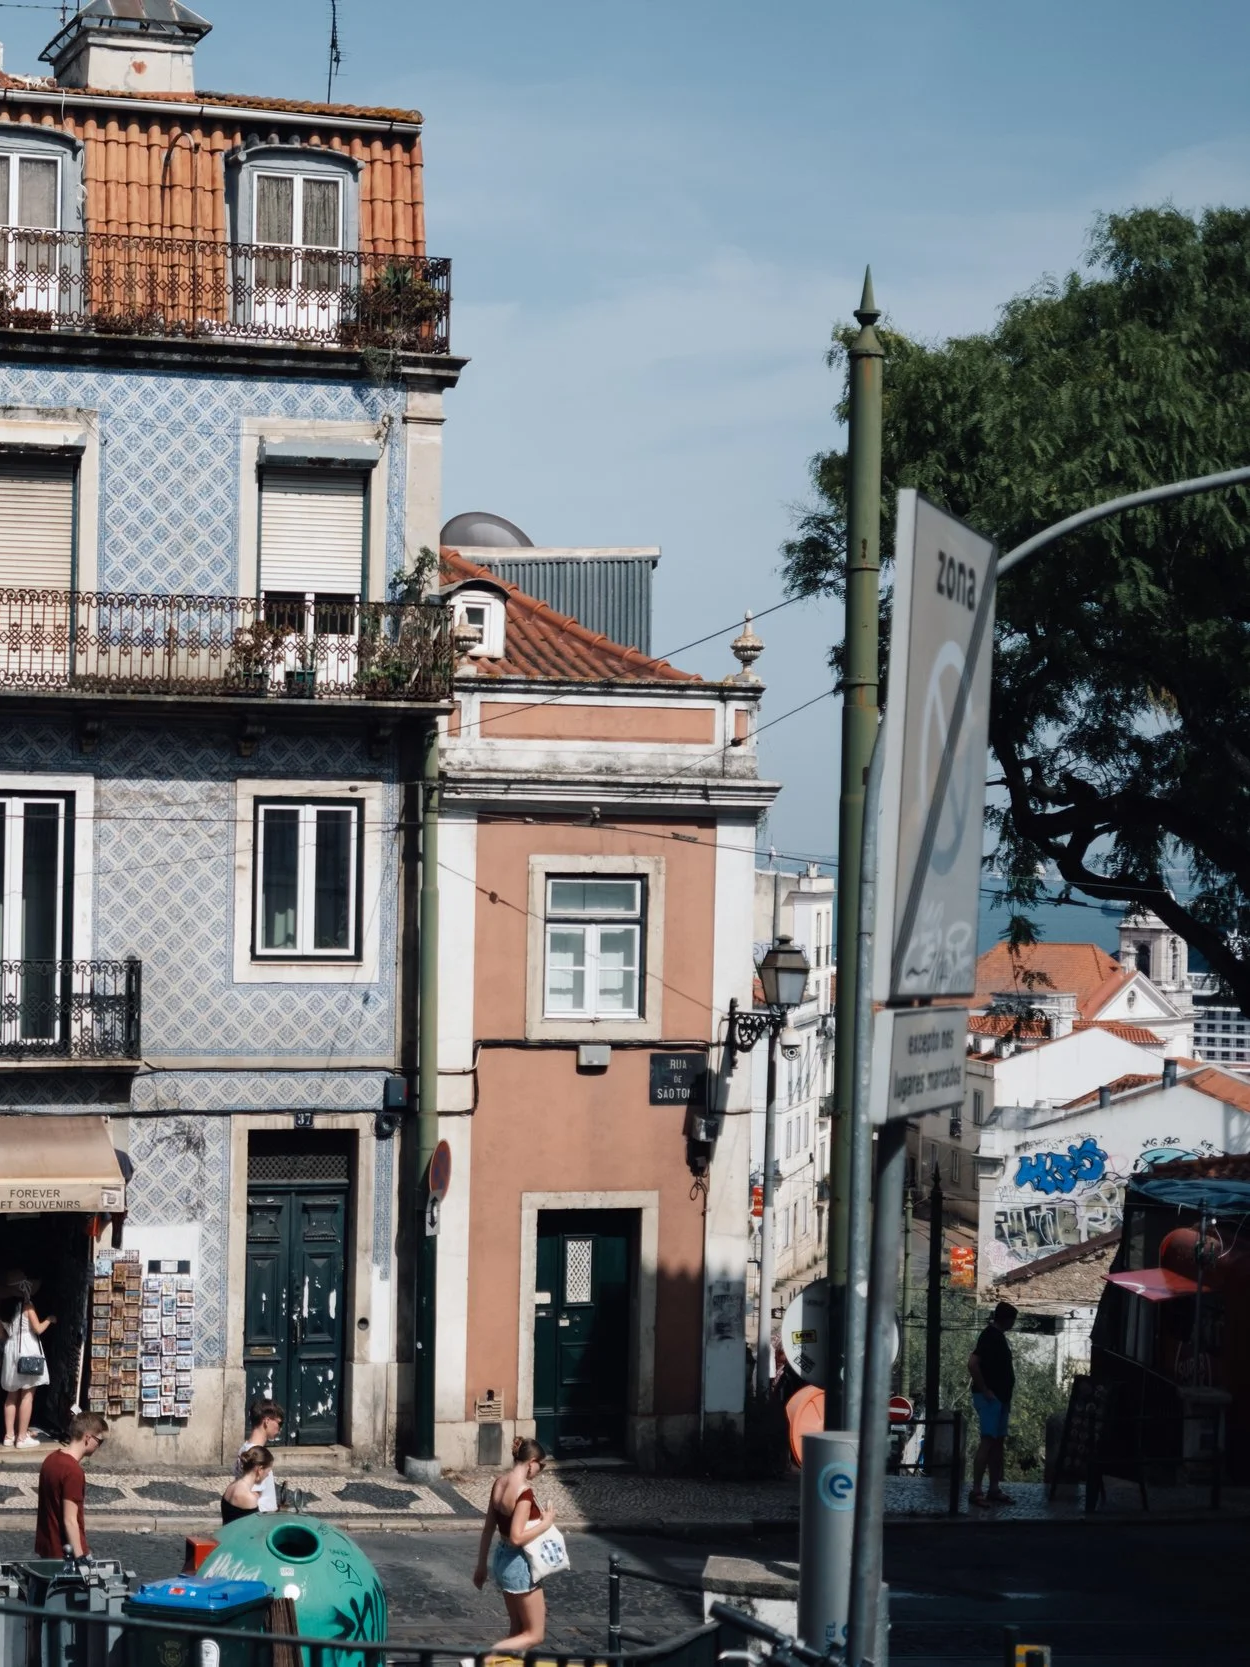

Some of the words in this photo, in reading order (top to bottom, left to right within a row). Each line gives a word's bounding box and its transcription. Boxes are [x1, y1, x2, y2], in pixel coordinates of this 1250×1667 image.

[936, 549, 976, 612] zona
[670, 1059, 687, 1069] RUA
[673, 1075, 683, 1083] DE
[657, 1085, 675, 1099] SÃO
[297, 1112, 311, 1125] 37
[9, 1189, 61, 1198] FOREVER
[19, 1200, 81, 1210] SOUVENIRS
